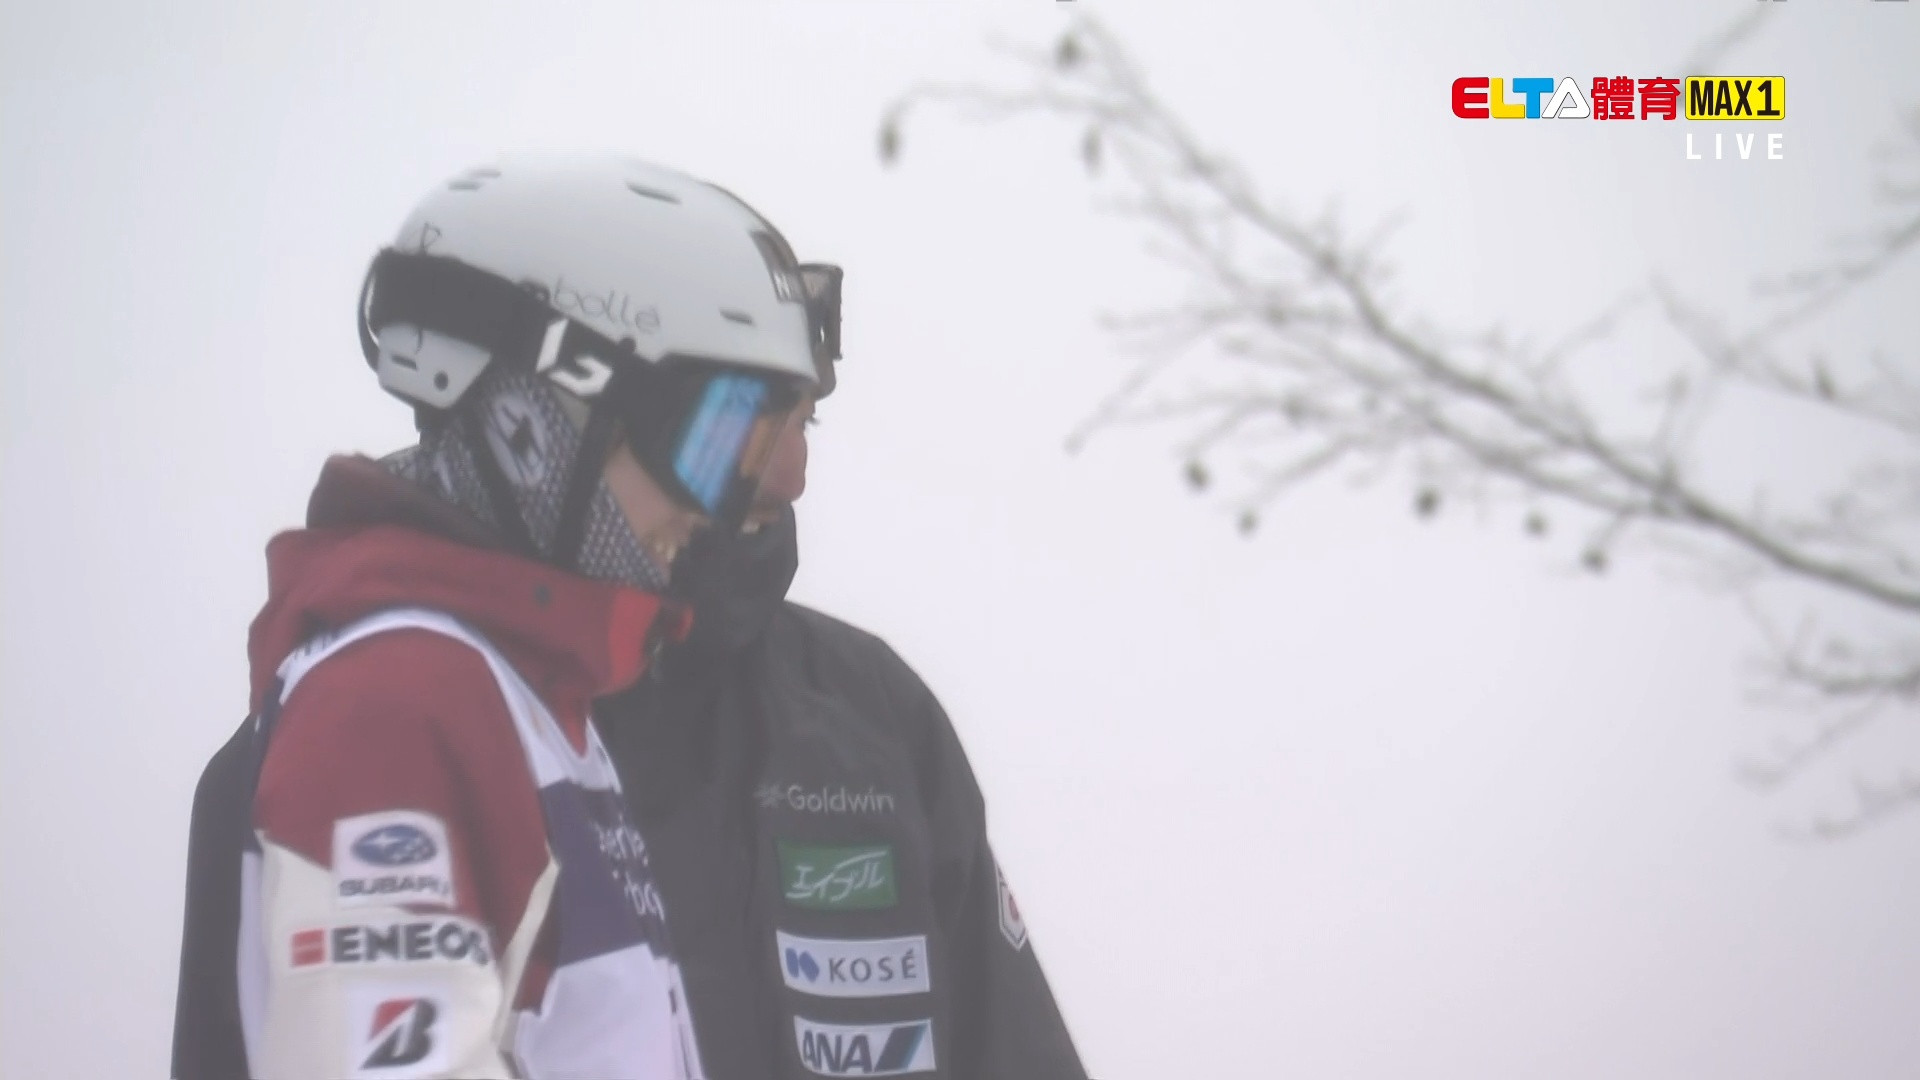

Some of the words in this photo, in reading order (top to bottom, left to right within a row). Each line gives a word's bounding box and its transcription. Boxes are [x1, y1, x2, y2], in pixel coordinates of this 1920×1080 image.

[786, 784, 895, 813] Goldwin
[332, 921, 489, 965] ENEOS
[828, 949, 918, 983] KOSÉ
[802, 1029, 873, 1074] ANA
